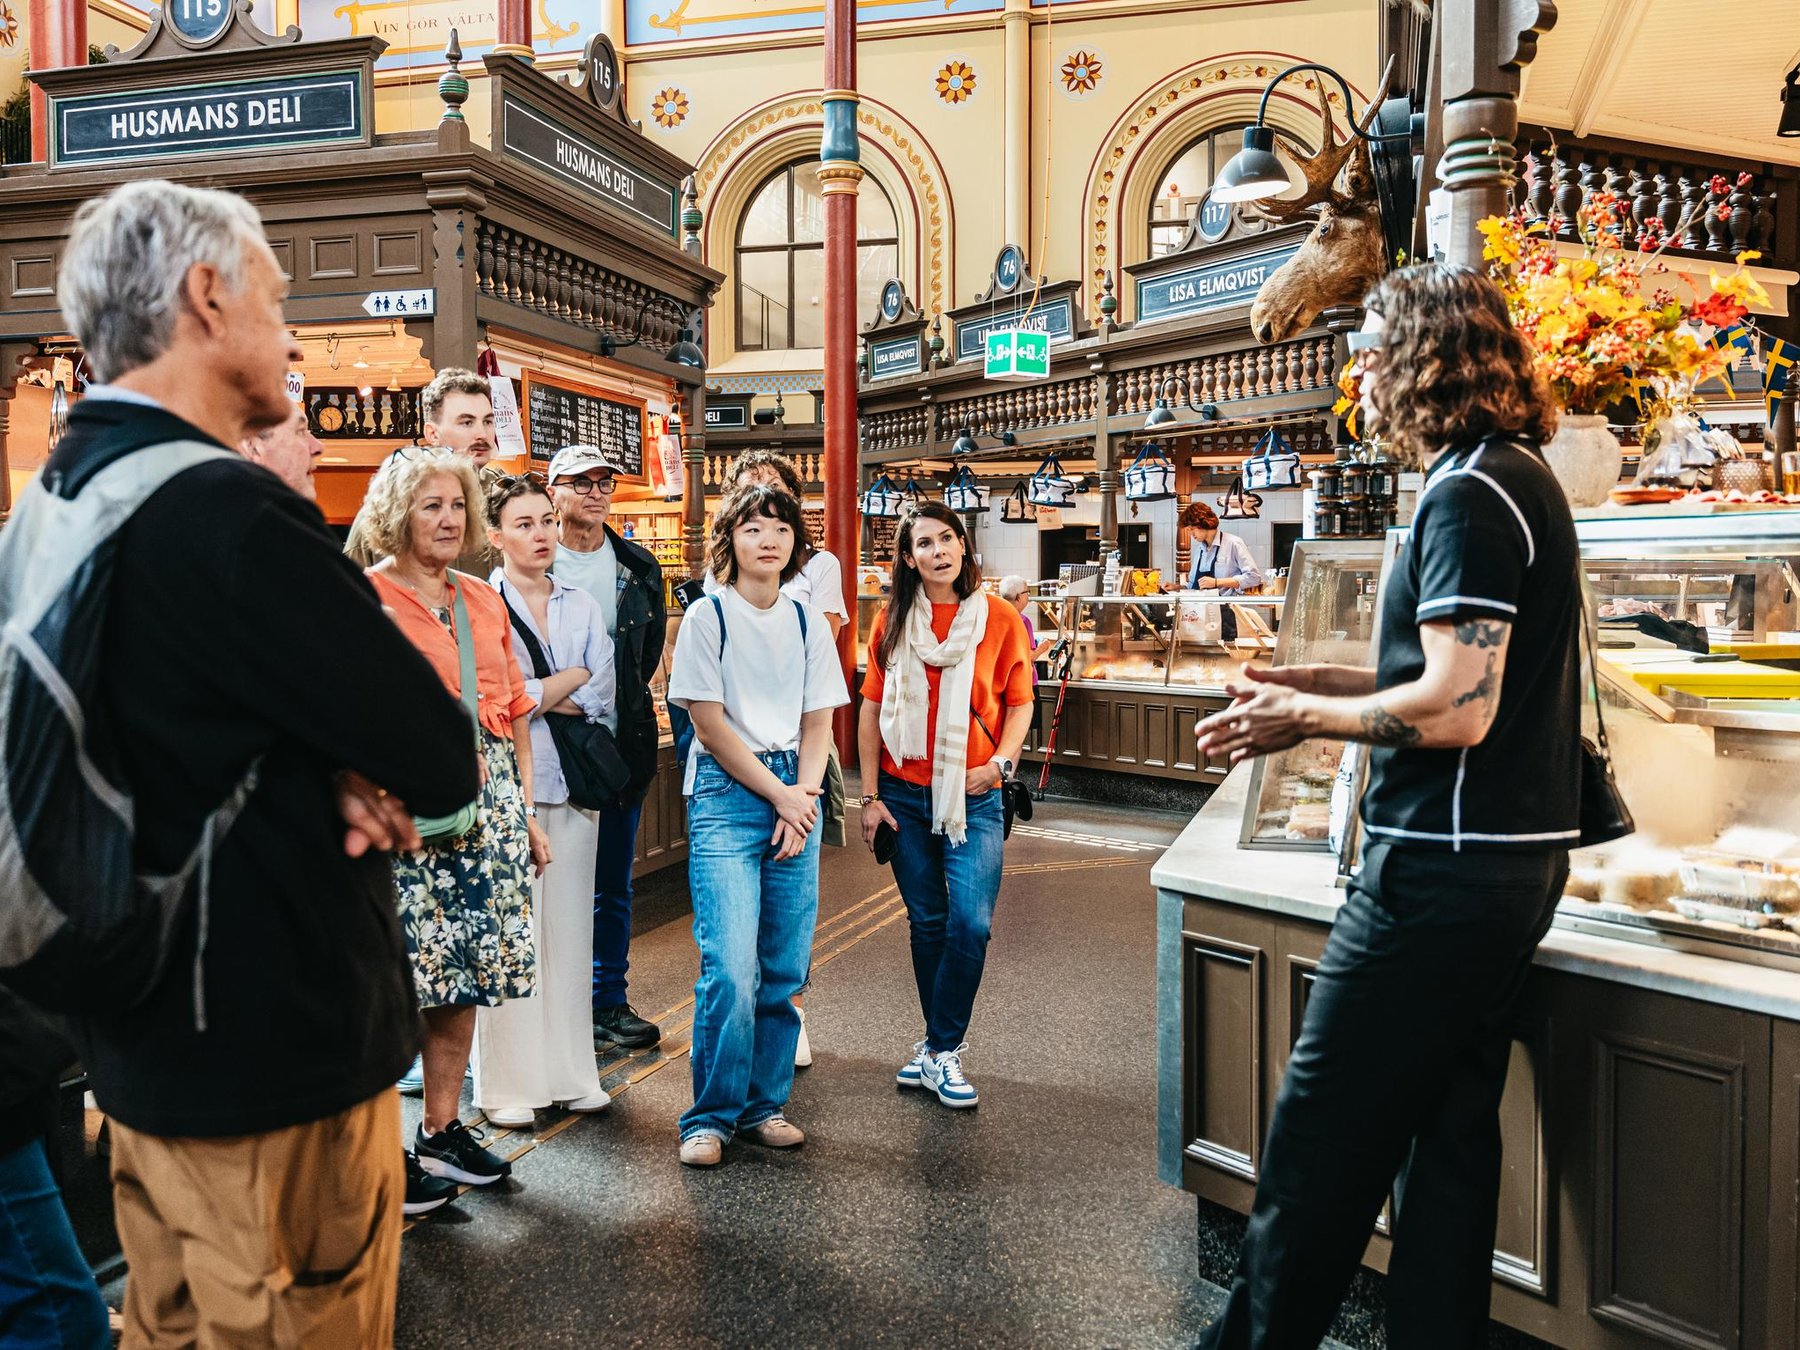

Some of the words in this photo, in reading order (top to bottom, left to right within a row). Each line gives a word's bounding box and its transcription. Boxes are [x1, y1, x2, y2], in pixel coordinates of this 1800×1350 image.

[593, 57, 611, 89] 115
[111, 101, 239, 139] HUSMANS
[248, 96, 301, 126] DELI
[556, 138, 612, 189] HUSMANS
[613, 170, 634, 201] DELI
[1204, 203, 1226, 224] 117
[1003, 259, 1015, 276] 76
[1169, 285, 1196, 303] LISA
[1200, 266, 1266, 296] ELMQVIST
[887, 293, 898, 308] 76
[1000, 314, 1048, 331] VIST
[877, 353, 889, 365] LISA
[889, 347, 916, 361] ELMQVIST
[285, 380, 301, 394] 00
